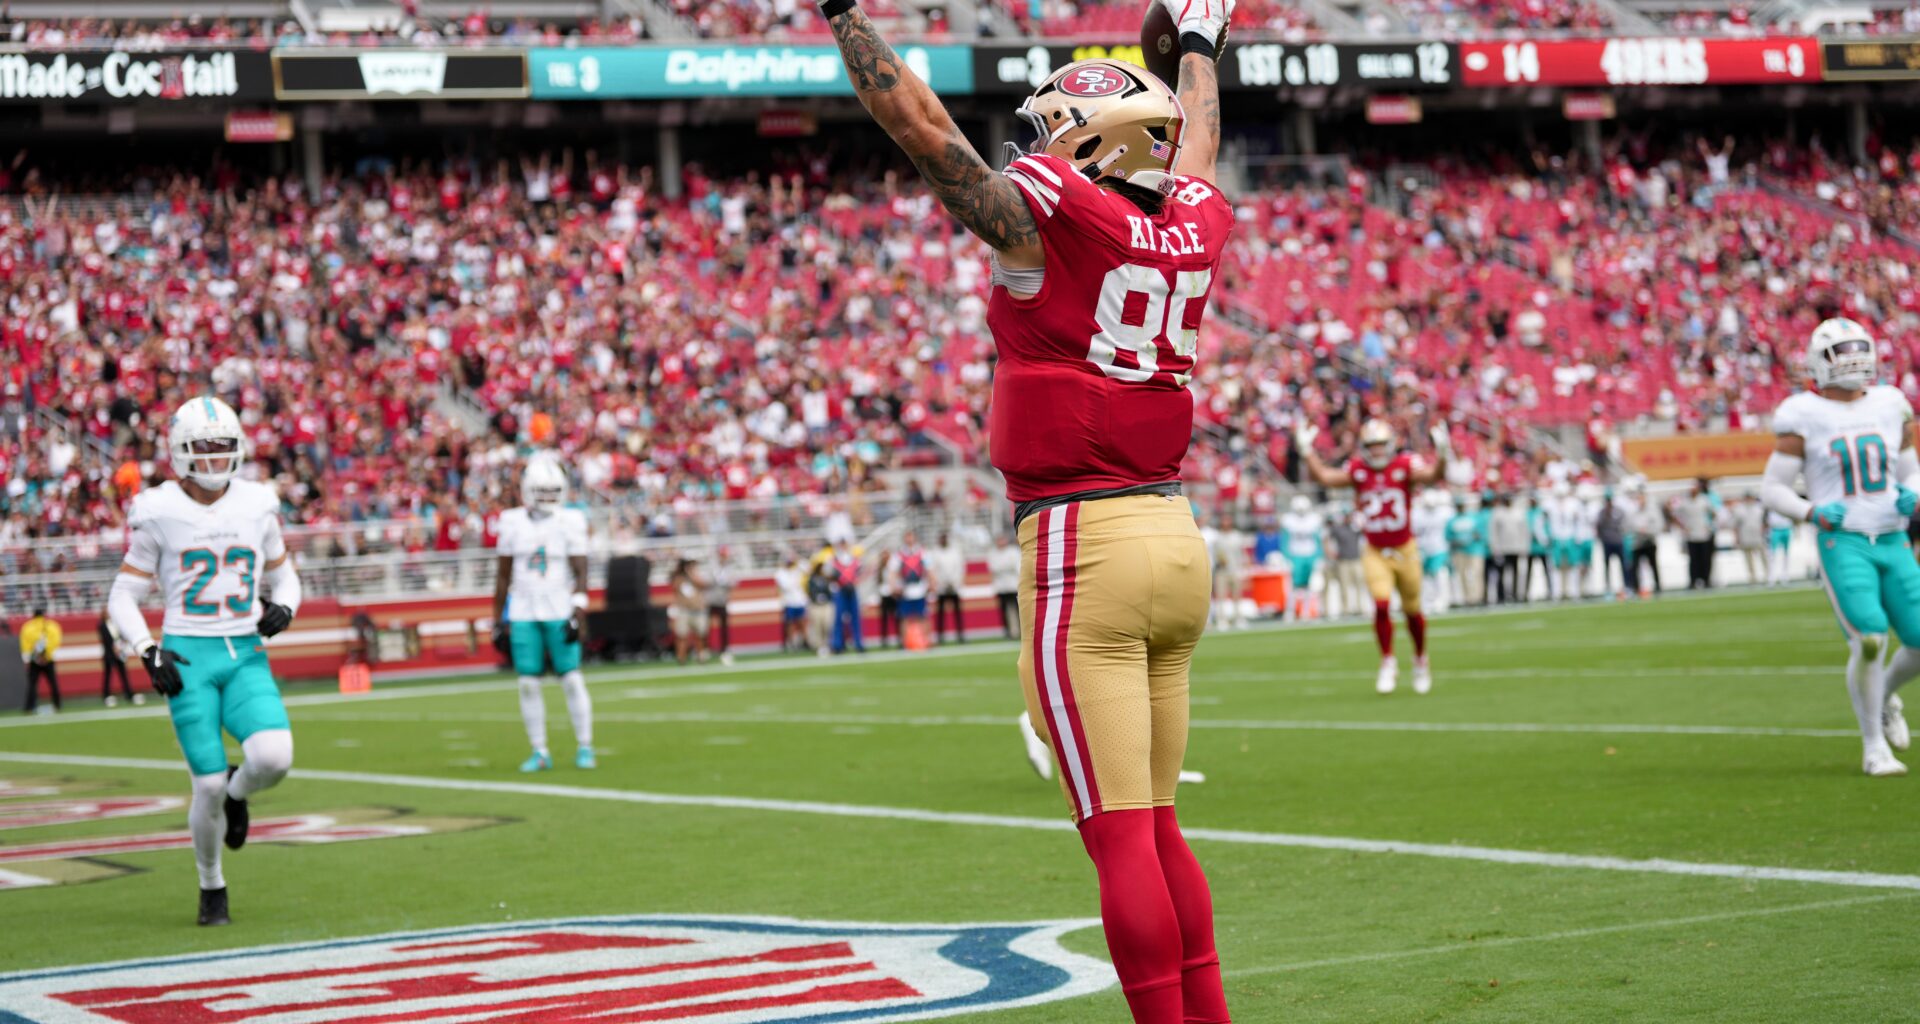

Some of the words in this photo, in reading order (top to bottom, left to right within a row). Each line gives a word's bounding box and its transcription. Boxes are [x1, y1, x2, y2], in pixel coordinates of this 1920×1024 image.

[0, 53, 86, 98] Made
[102, 51, 239, 98] Coctail
[580, 56, 600, 92] 3
[664, 49, 838, 91] Dolphins
[1236, 44, 1284, 86] 1ST
[1305, 43, 1340, 86] 10
[1416, 42, 1450, 83] 12
[1502, 42, 1540, 82] 14
[1601, 38, 1709, 84] 49ERS
[1787, 43, 1805, 77] 3
[1086, 262, 1212, 386] 85
[1829, 433, 1888, 497] 10
[1360, 488, 1407, 533] 23
[180, 545, 258, 618] 23
[528, 545, 547, 578] 4
